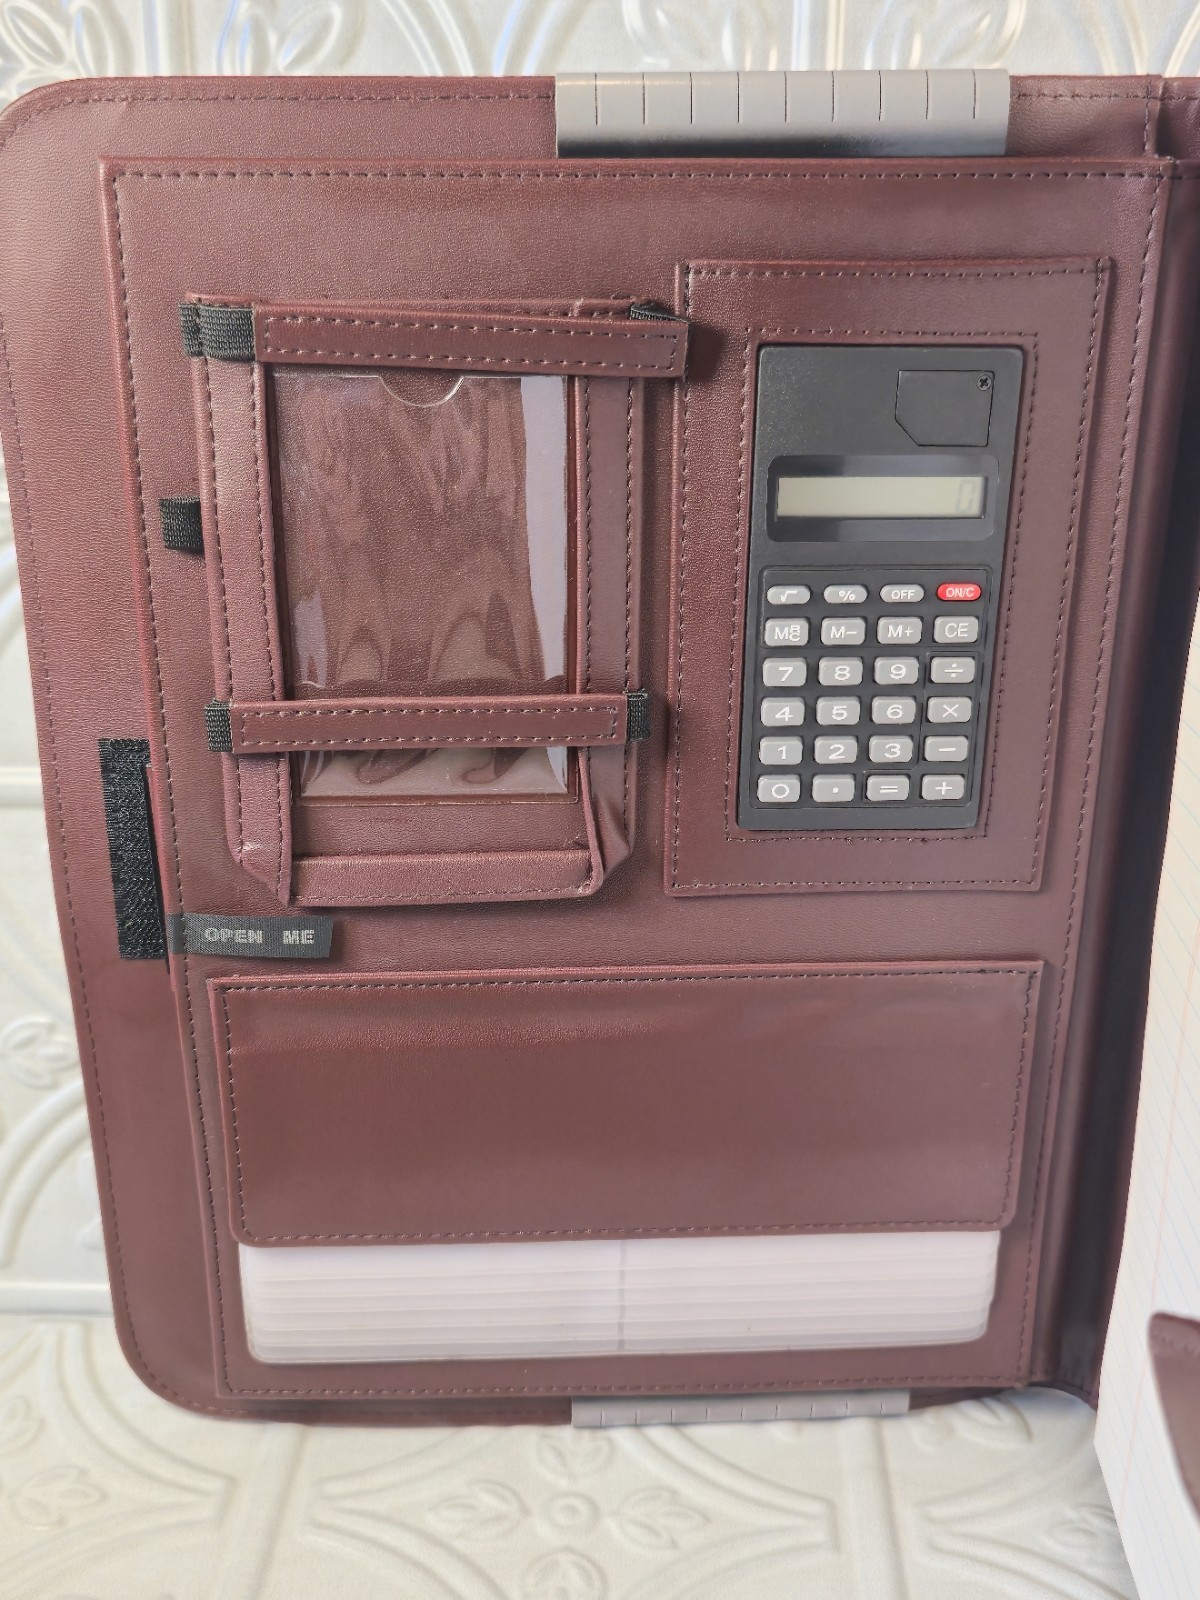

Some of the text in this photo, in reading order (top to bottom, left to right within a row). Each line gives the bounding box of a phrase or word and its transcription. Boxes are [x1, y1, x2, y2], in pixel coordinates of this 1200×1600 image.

[956, 479, 976, 513] 0
[838, 590, 856, 602] %
[890, 589, 916, 600] OFF
[945, 587, 975, 598] ON/C
[887, 624, 914, 638] M+
[944, 623, 969, 638] CE
[778, 666, 794, 682] 7
[833, 665, 851, 681] 8
[889, 663, 907, 680] 9
[774, 706, 794, 722] 4
[831, 705, 848, 721] 5
[886, 704, 903, 720] 6
[777, 745, 787, 760] 1
[827, 744, 846, 760] 2
[883, 743, 902, 759] 3
[771, 783, 790, 799] 0
[934, 781, 953, 795] +
[204, 927, 315, 945] OPEN ME
